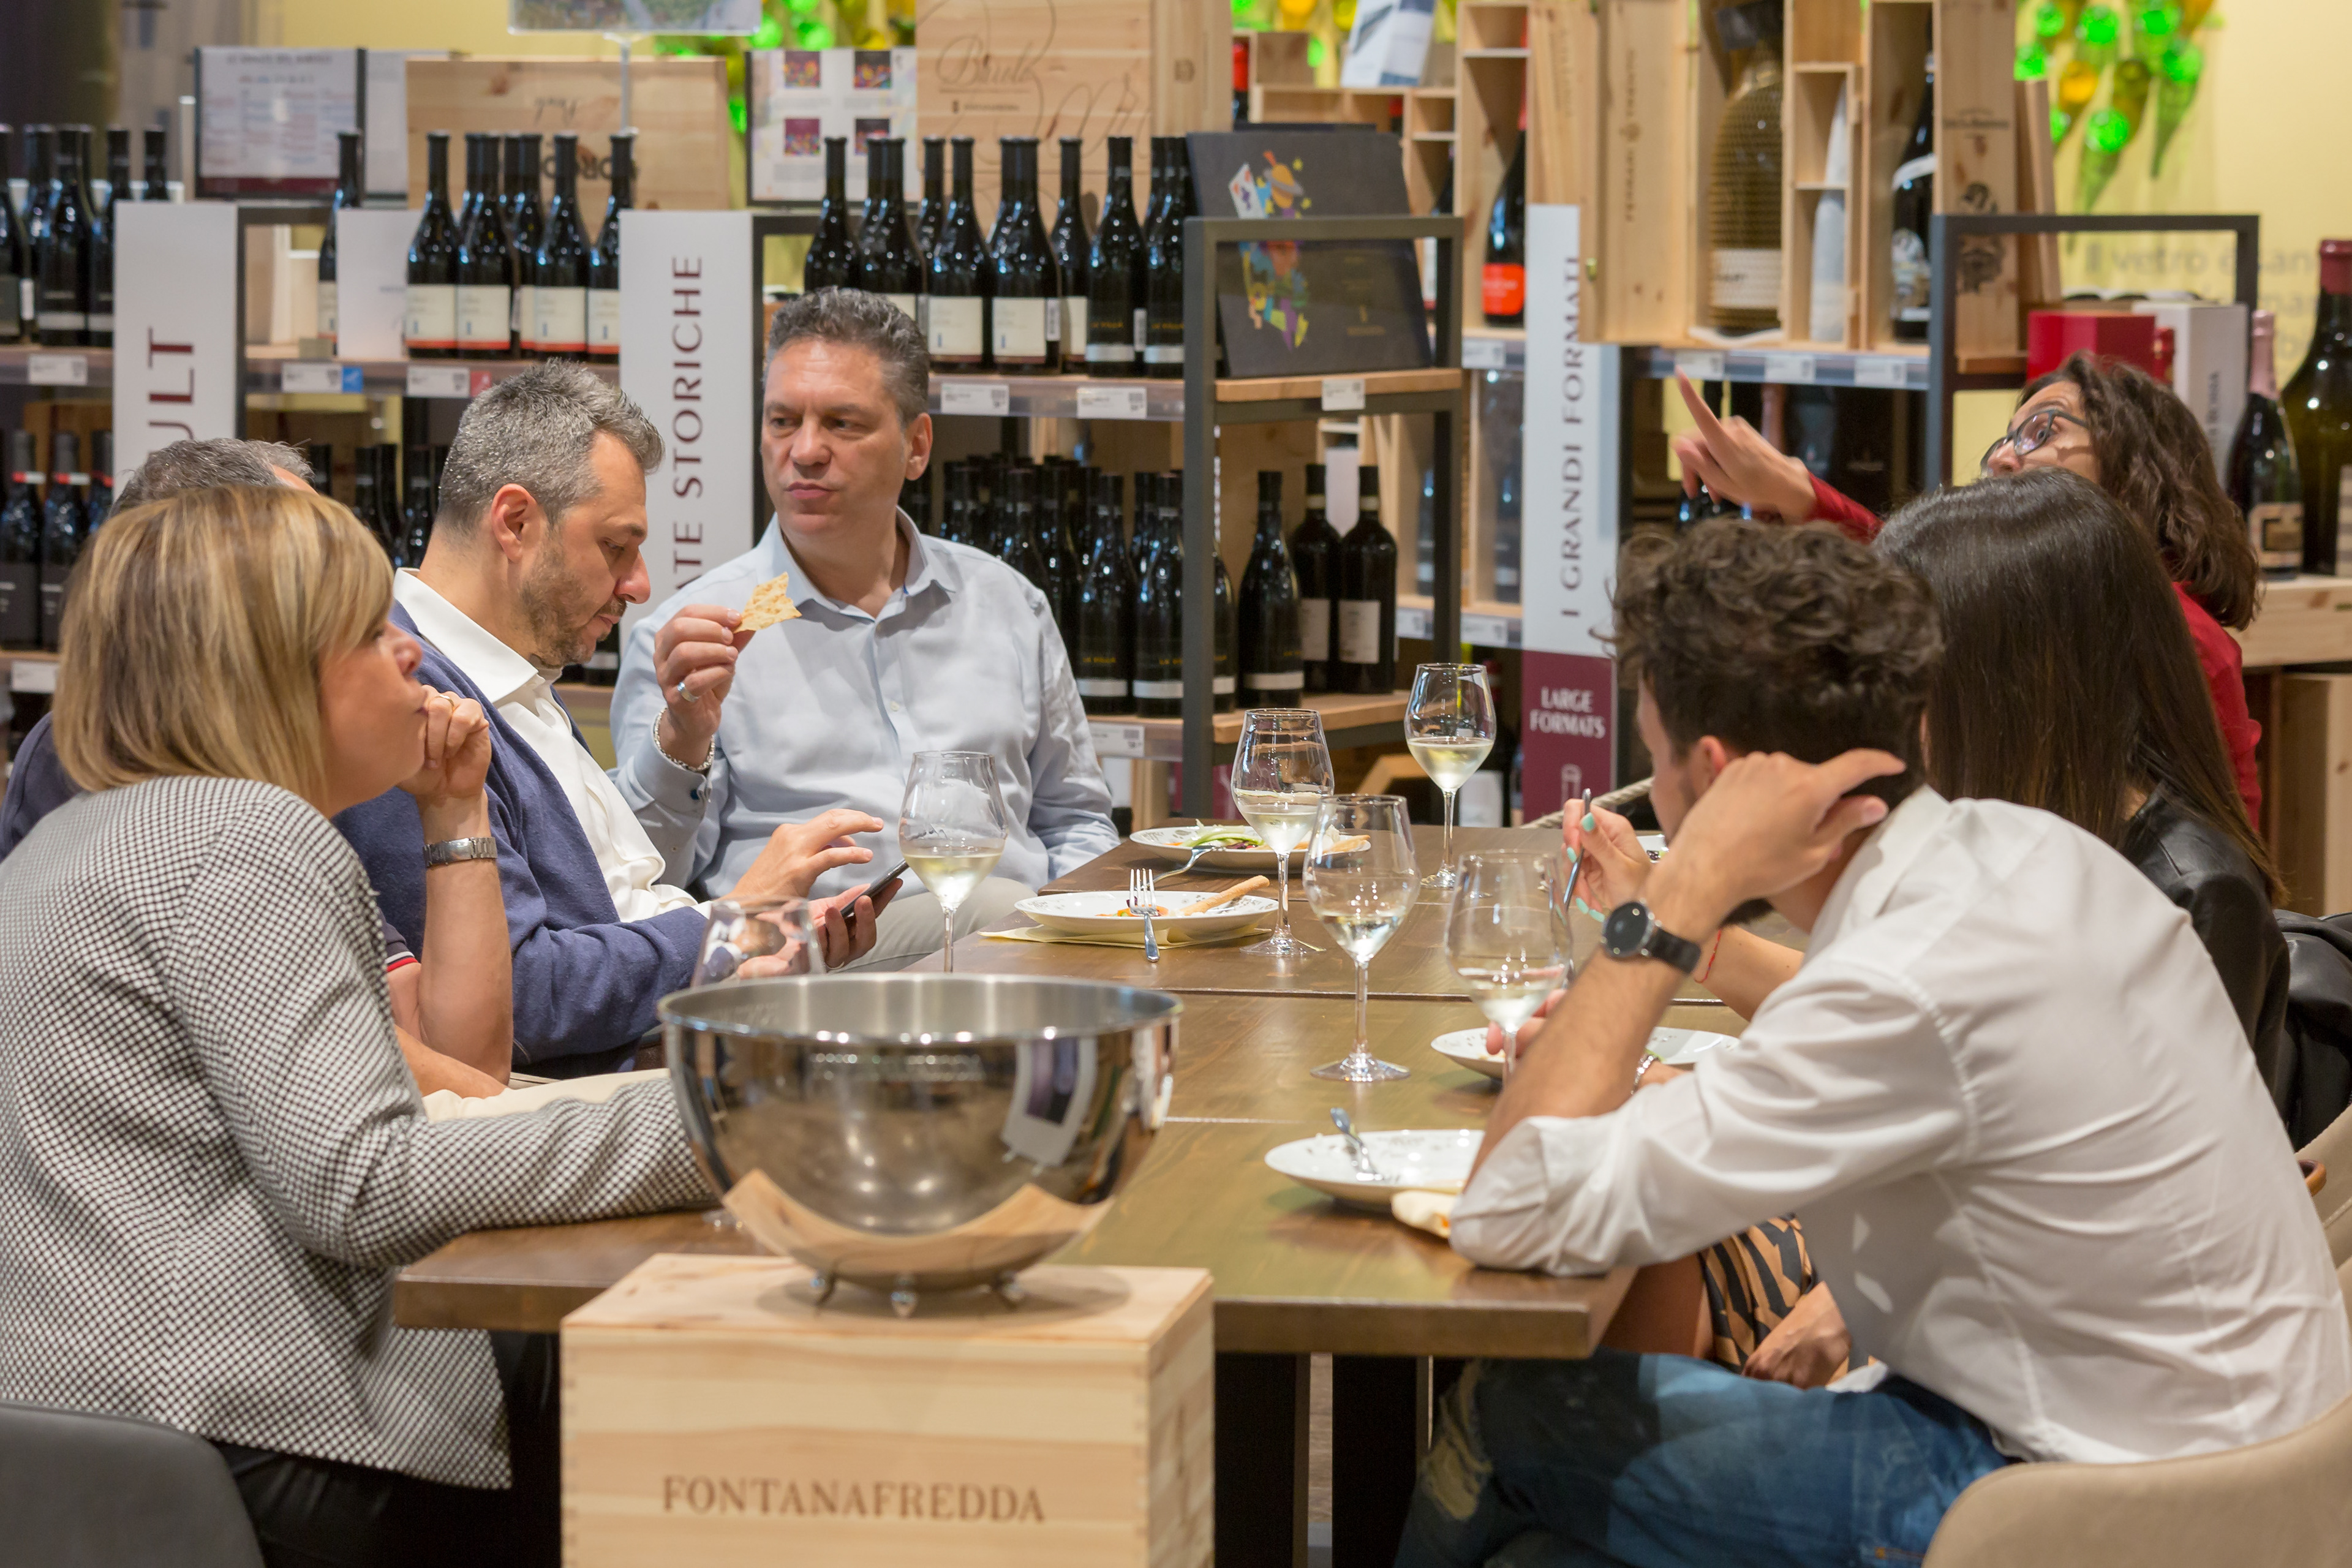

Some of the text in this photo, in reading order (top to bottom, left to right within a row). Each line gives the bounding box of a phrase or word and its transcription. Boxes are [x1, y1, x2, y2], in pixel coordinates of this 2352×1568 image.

[672, 257, 703, 499] STORICHE
[1561, 445, 1583, 590] GRANDI
[1529, 709, 1606, 739] FORMATS
[1540, 686, 1594, 713] LARGE
[662, 1475, 1046, 1525] FONTANAFREDDA
